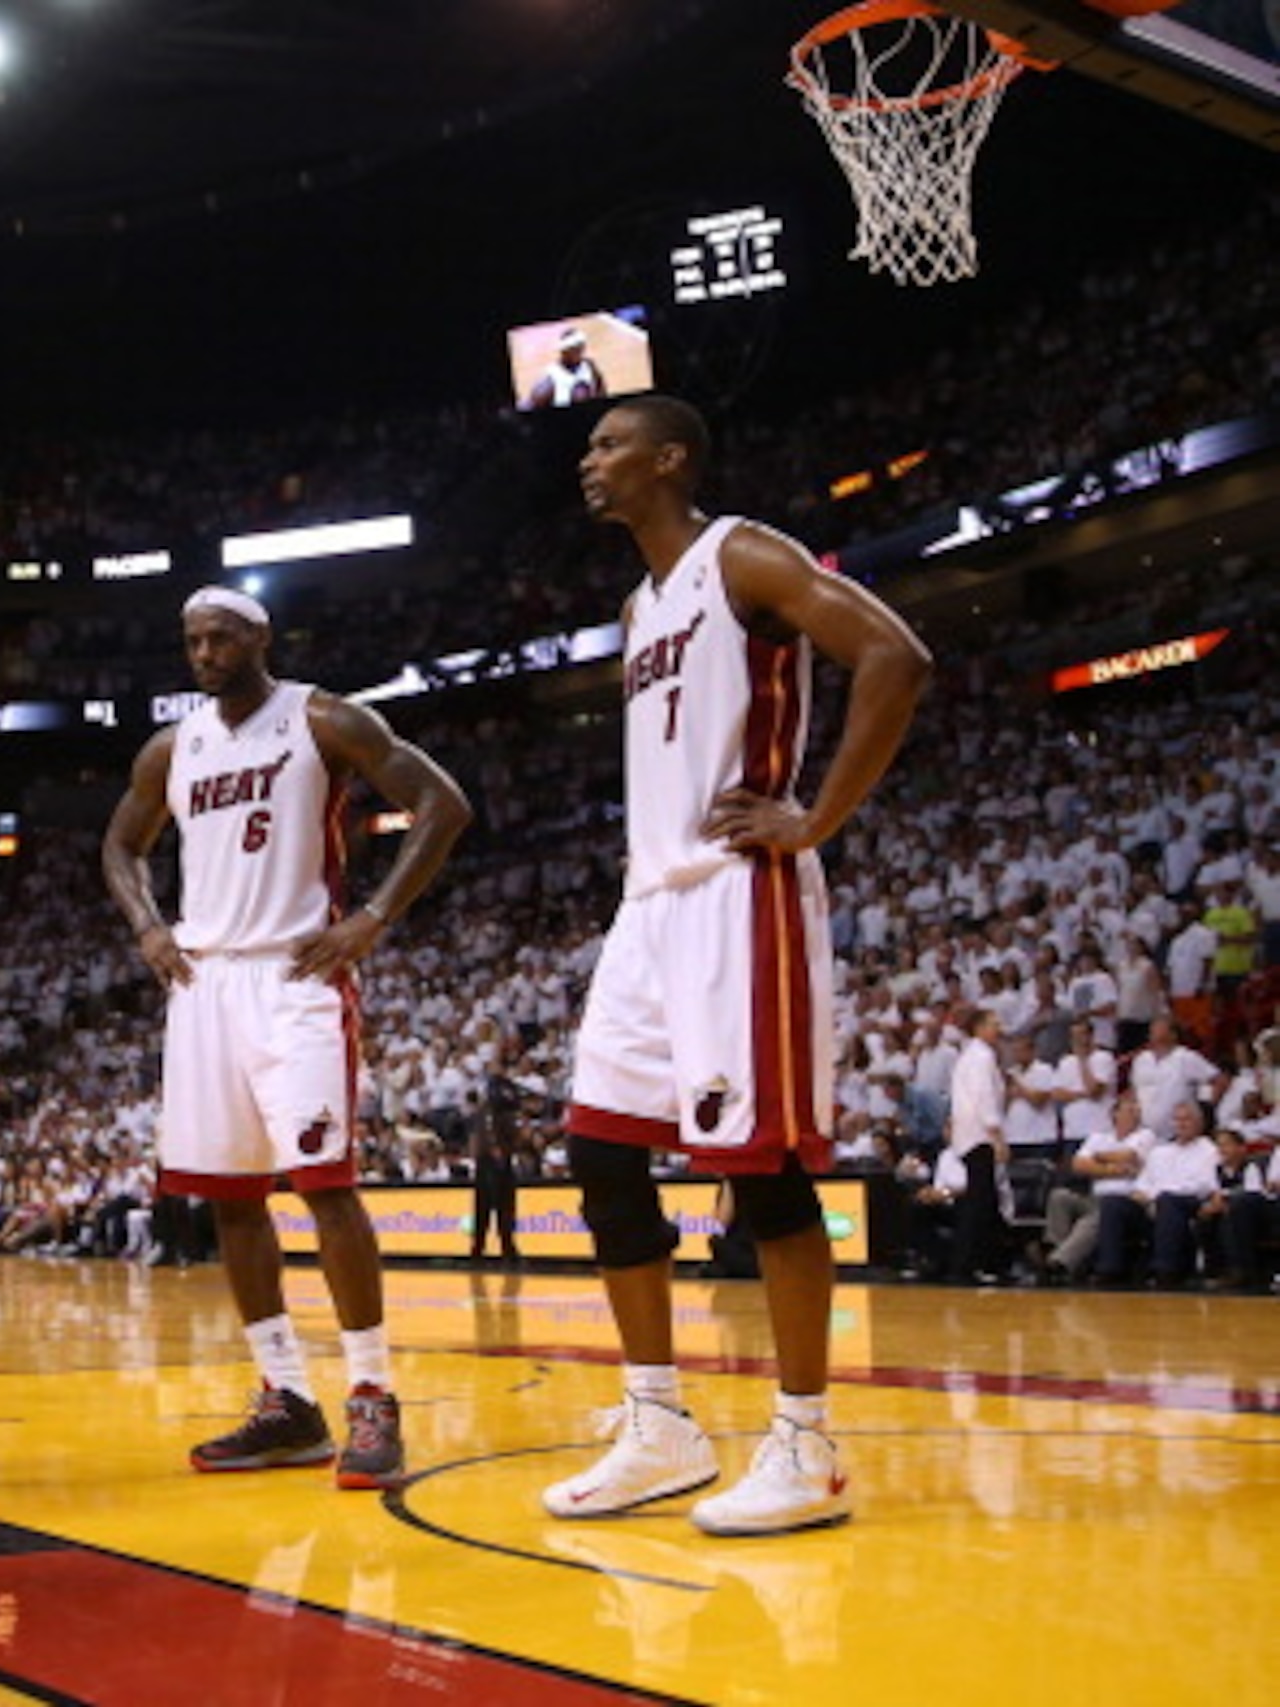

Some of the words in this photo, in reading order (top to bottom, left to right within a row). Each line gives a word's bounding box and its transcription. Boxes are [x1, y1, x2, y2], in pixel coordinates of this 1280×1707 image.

[1088, 636, 1197, 685] BACARDI
[664, 685, 682, 743] 1
[188, 748, 294, 819] HEAT
[241, 809, 272, 853] 6
